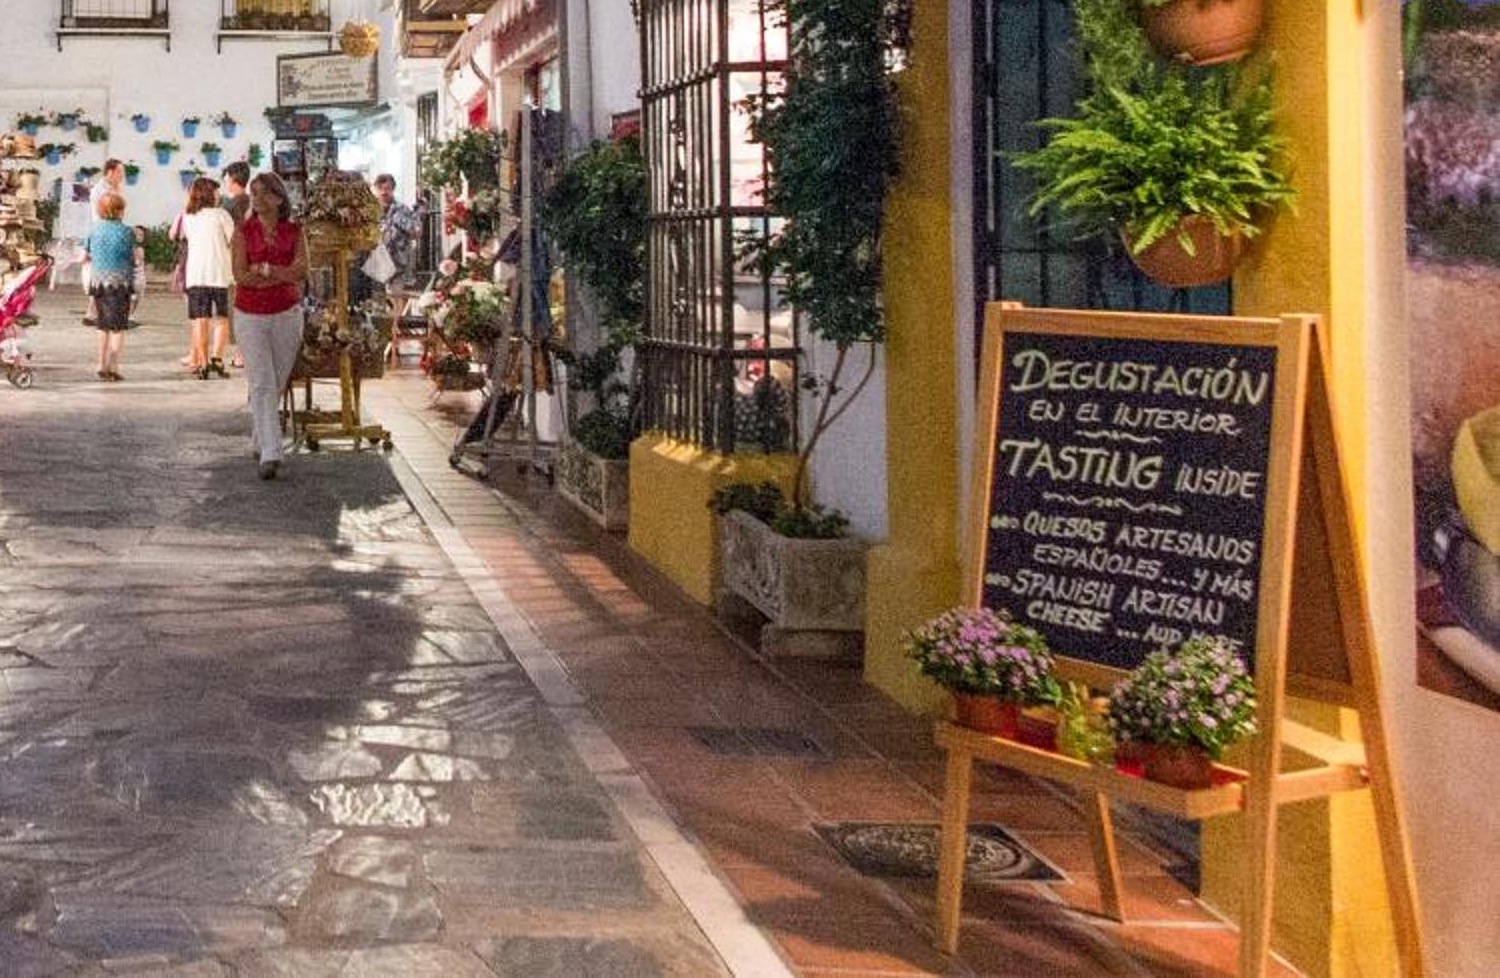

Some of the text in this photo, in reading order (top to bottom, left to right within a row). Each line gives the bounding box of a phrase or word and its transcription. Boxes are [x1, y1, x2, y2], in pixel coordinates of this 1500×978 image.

[1010, 349, 1269, 405] DEGUSTACIÓN
[1029, 398, 1244, 436] EN EL INTERIOR
[1000, 437, 1261, 498] TASTING INSIDE
[1023, 510, 1256, 564] QUESOS ARTESANOS
[1011, 568, 1225, 625] SPANISH ARTISAN
[1209, 569, 1253, 601] MÁS
[1027, 600, 1111, 632] CHEESE
